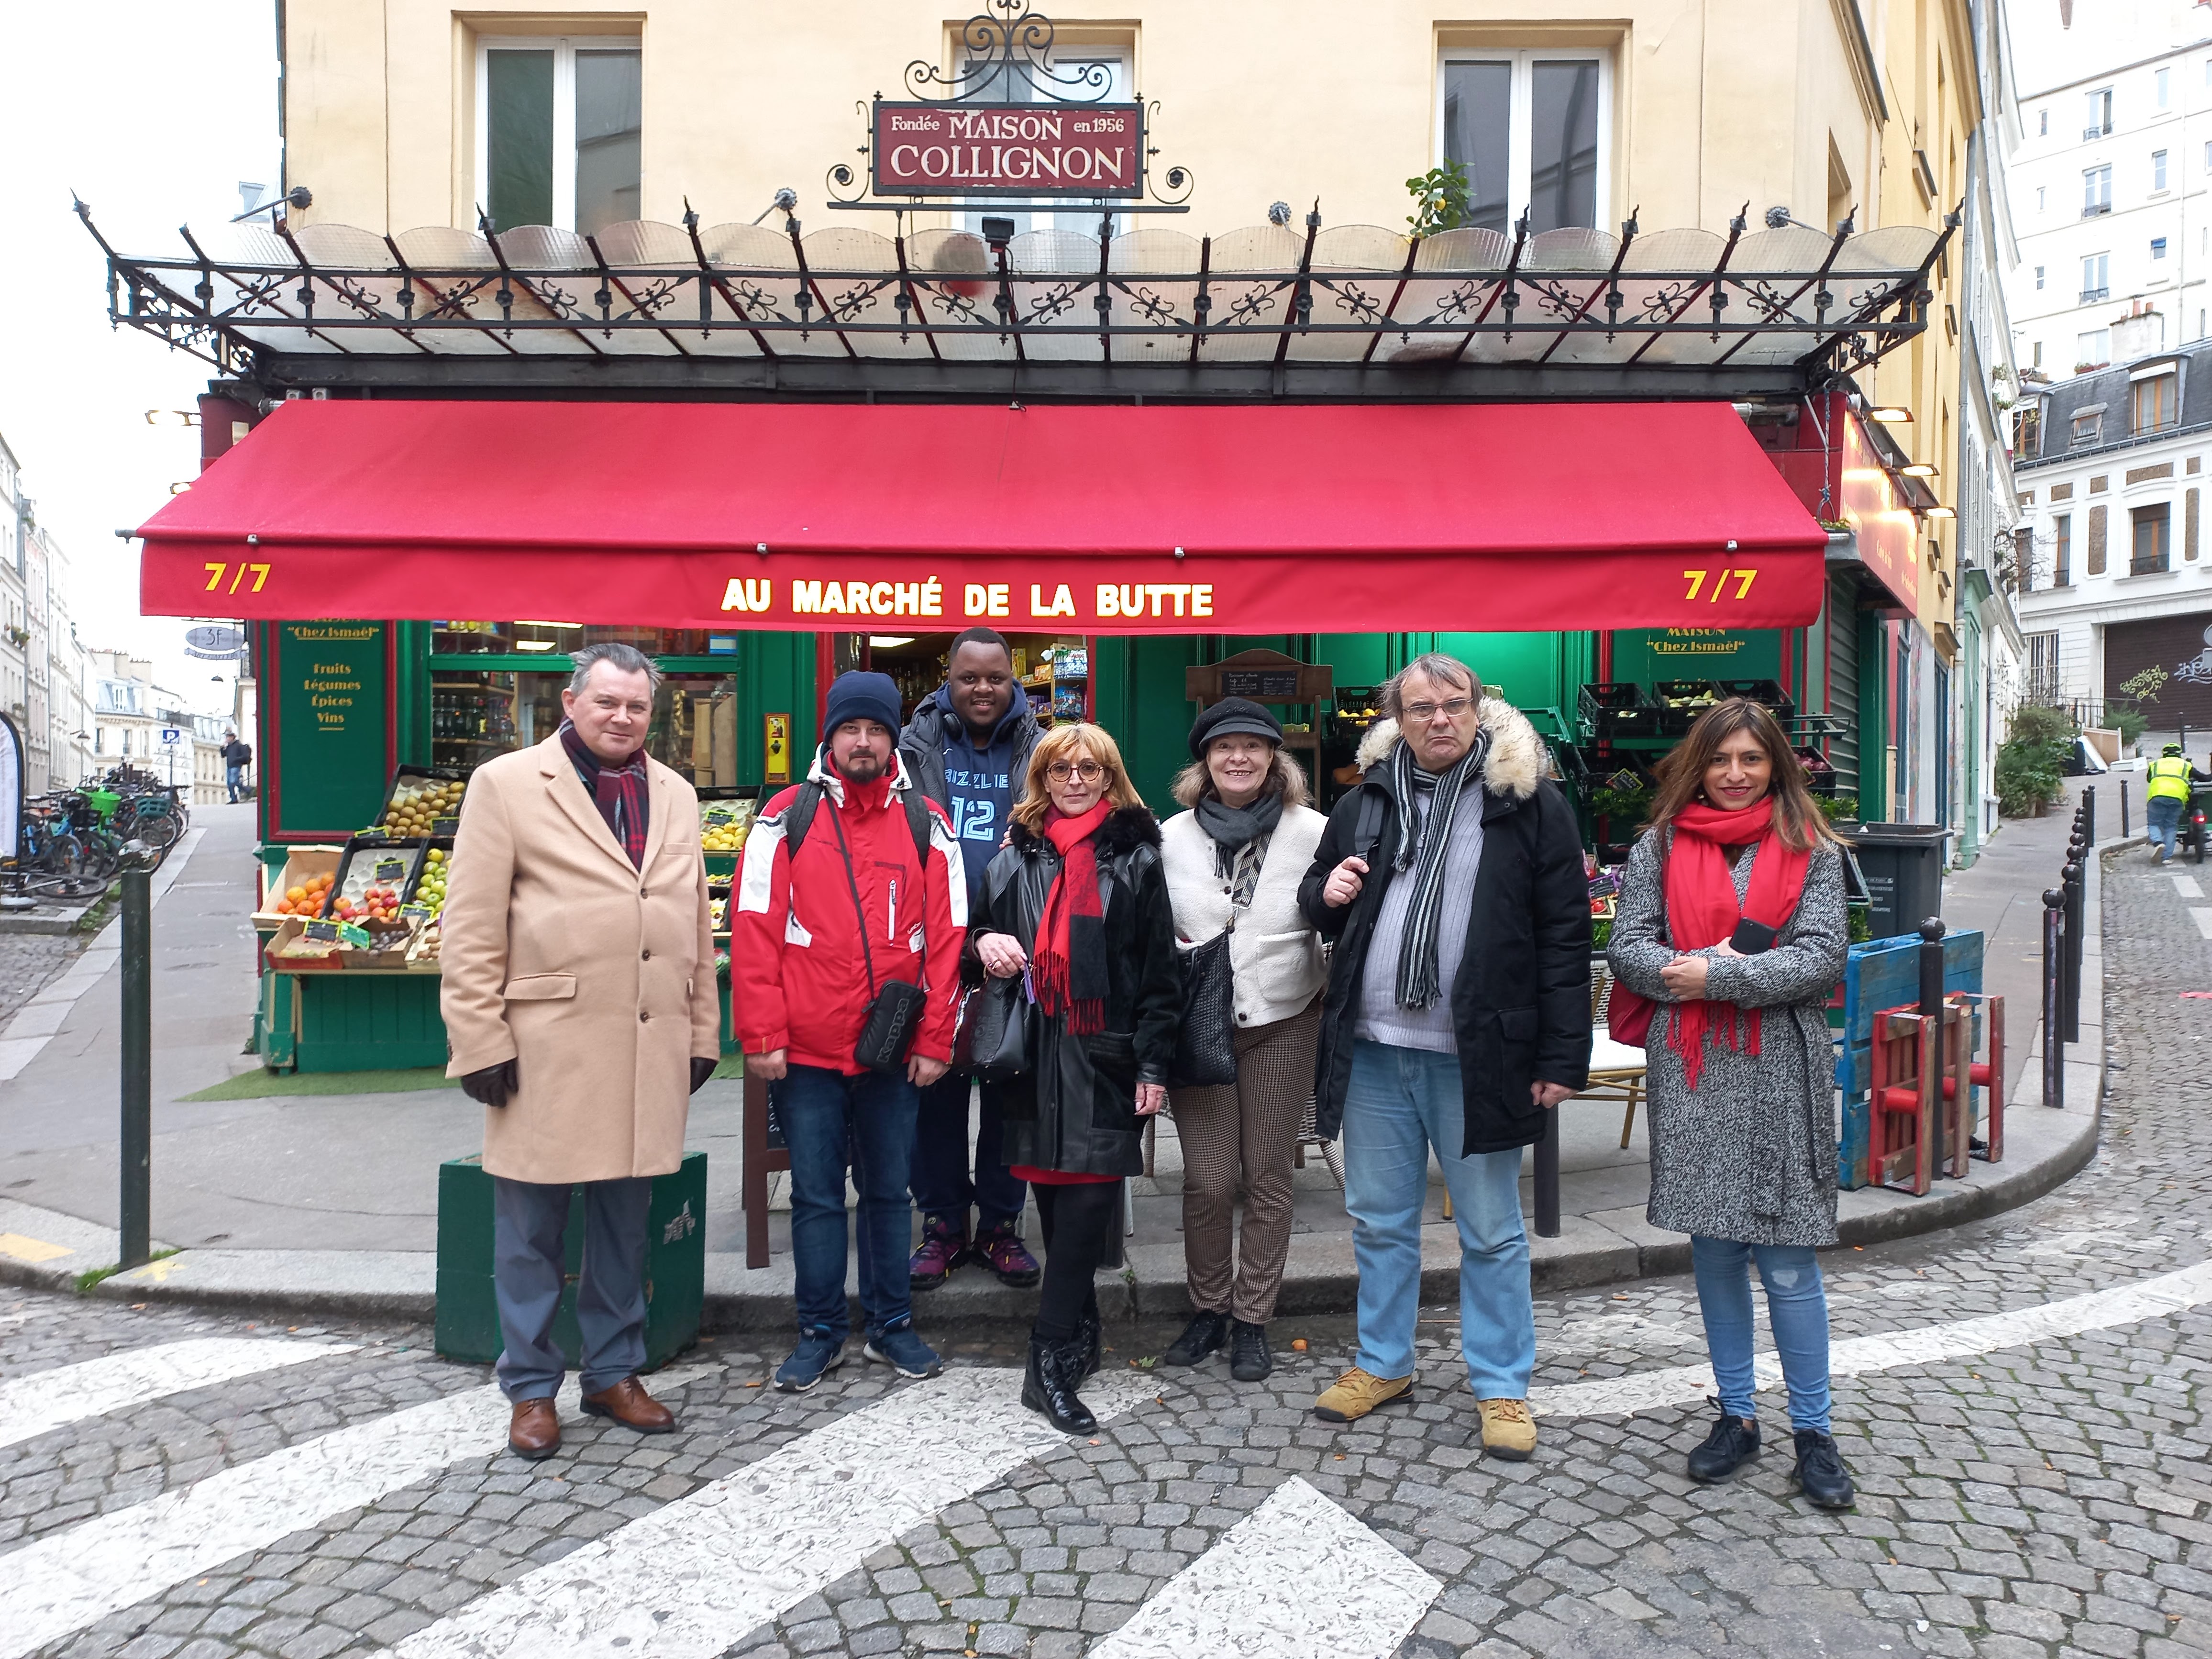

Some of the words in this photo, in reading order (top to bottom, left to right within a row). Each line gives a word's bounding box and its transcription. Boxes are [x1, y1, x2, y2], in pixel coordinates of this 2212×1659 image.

[891, 116, 940, 131] Fondée
[949, 116, 1063, 140] MAISON
[1073, 122, 1091, 133] en
[1092, 119, 1124, 133] 1956
[890, 144, 1124, 180] COLLIGNON
[205, 562, 271, 595] 7/7
[1683, 568, 1758, 603] 7/7
[720, 578, 772, 612] AU
[792, 575, 943, 616] MARCHÉ
[963, 583, 1010, 617] DE
[1030, 583, 1076, 617] LA
[1096, 583, 1214, 617] BUTTE
[304, 678, 361, 692] Légumes
[313, 663, 352, 674] Fruits
[317, 712, 344, 723] Vins
[951, 795, 995, 841] 12
[876, 998, 909, 1063] Kappa
